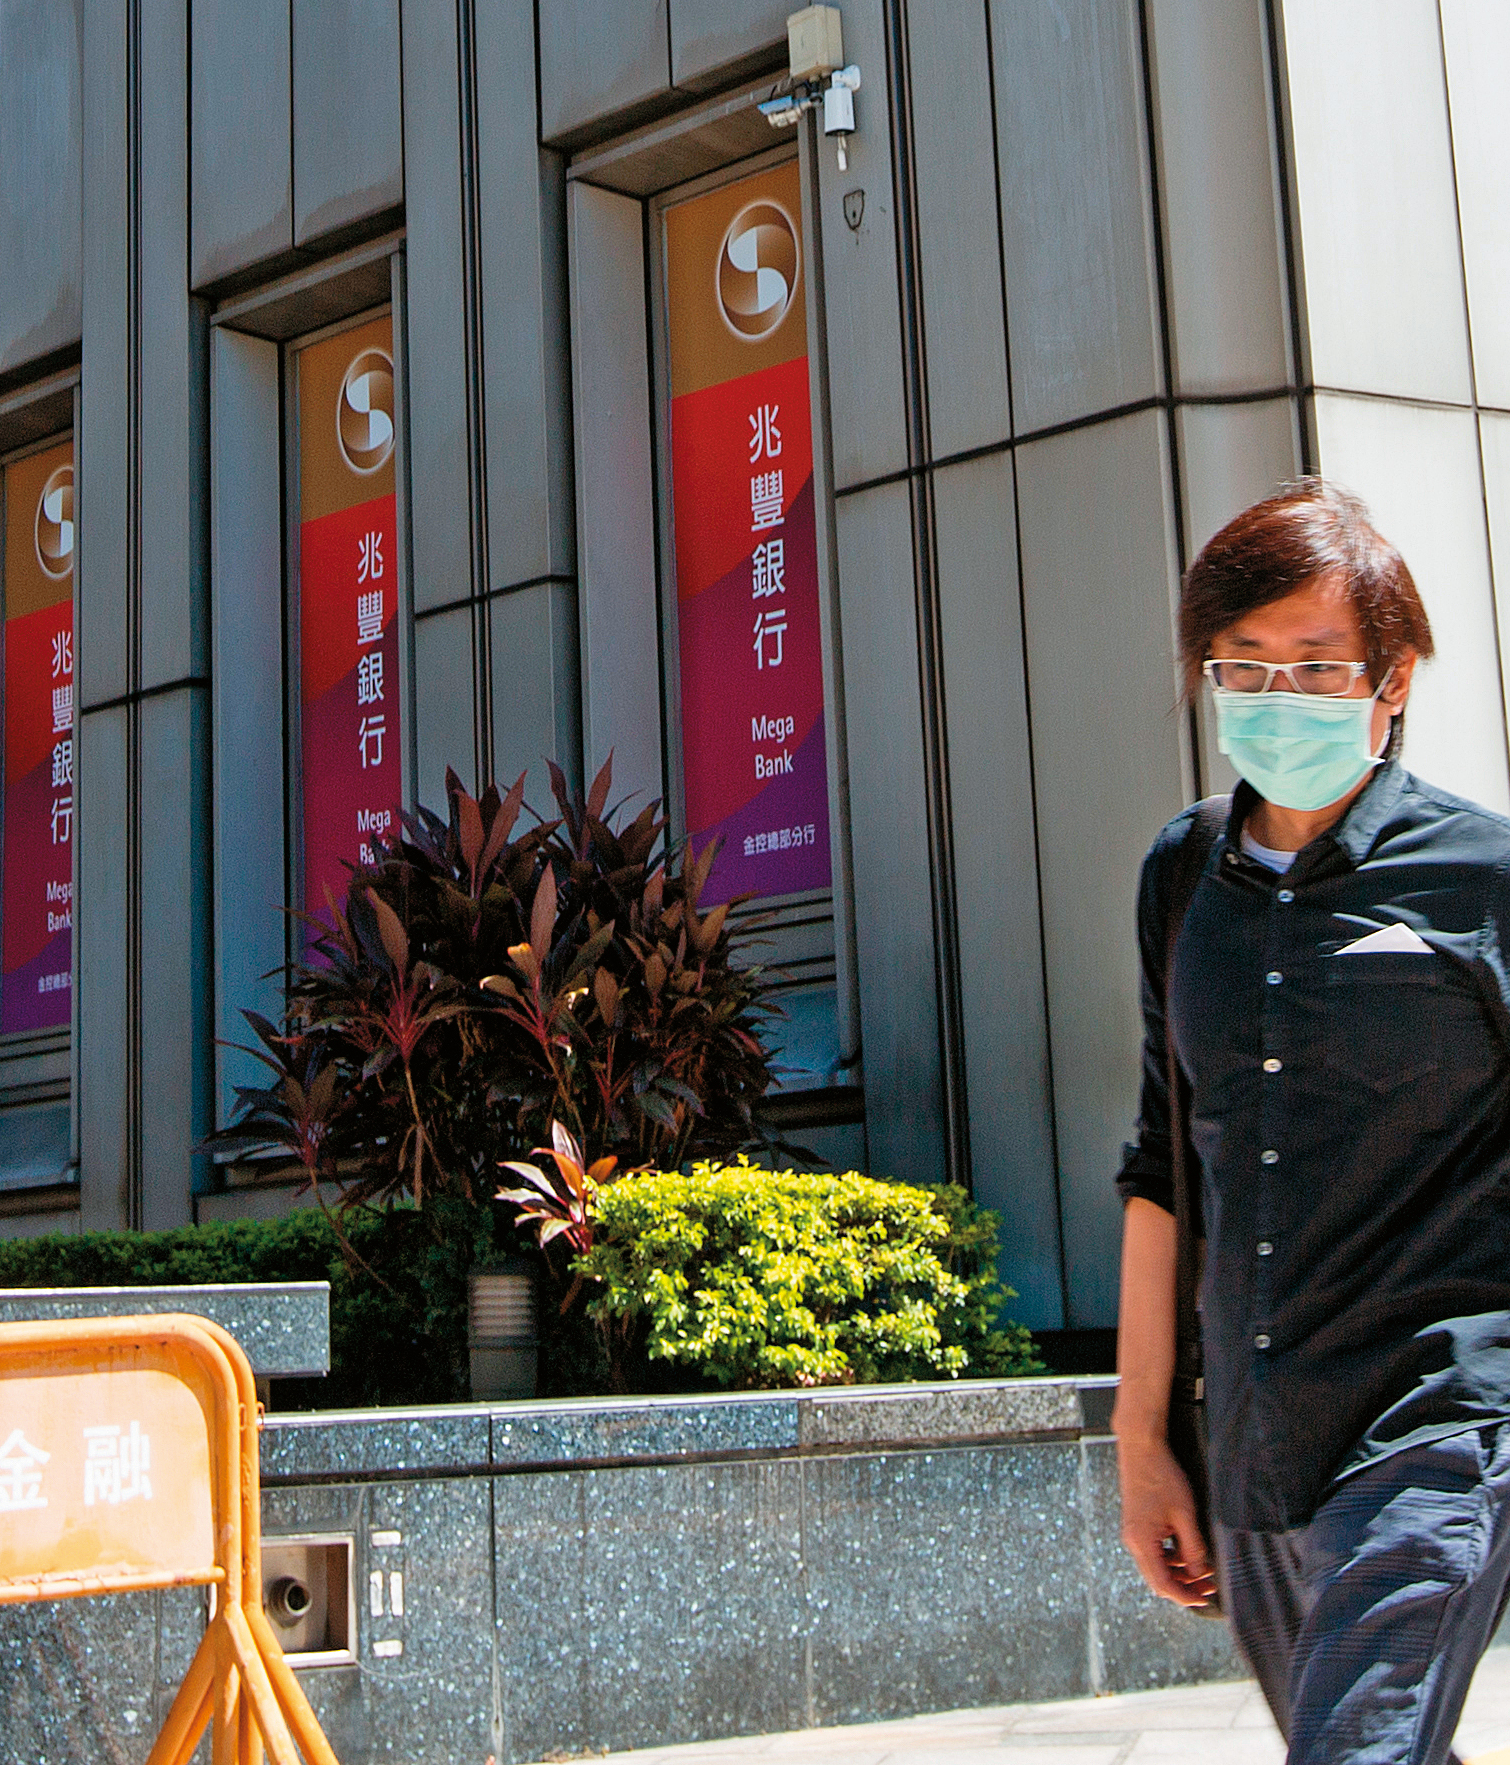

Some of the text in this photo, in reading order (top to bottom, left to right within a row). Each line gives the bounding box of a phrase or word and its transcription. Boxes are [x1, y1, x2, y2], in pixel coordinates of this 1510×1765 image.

[748, 403, 788, 672] 兆豐銀行
[356, 530, 387, 771] 兆豐銀行
[51, 631, 73, 845] 兆豐銀行
[751, 715, 795, 743] Mega
[755, 749, 794, 780] Bank
[357, 808, 391, 834] Mega
[360, 839, 390, 865] Ba
[743, 823, 816, 857] 金控總部分行
[48, 907, 72, 932] Bank
